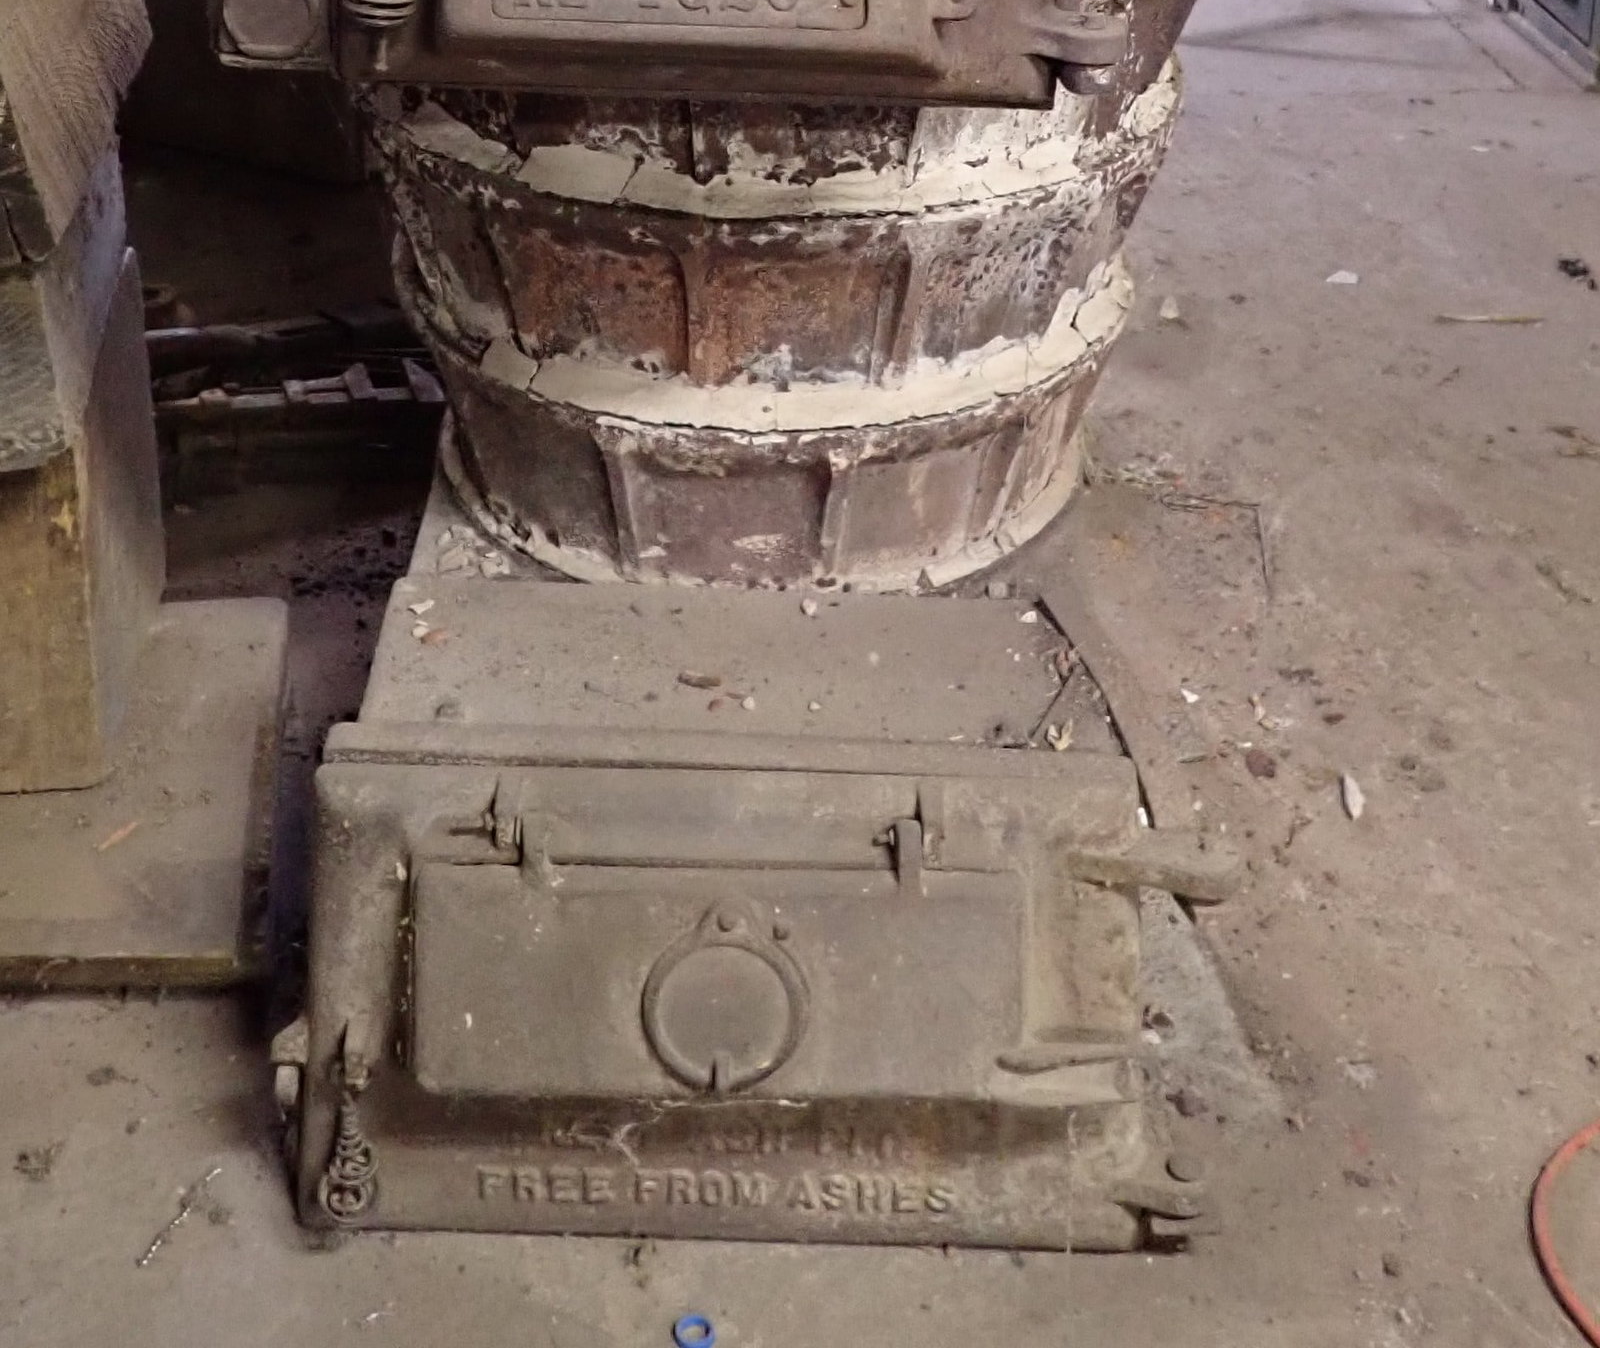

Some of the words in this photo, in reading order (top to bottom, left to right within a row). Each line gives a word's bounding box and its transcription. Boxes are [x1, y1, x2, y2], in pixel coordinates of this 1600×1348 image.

[475, 1165, 613, 1204] FREE
[632, 1168, 769, 1207] FROM
[786, 1173, 956, 1214] ASHES
